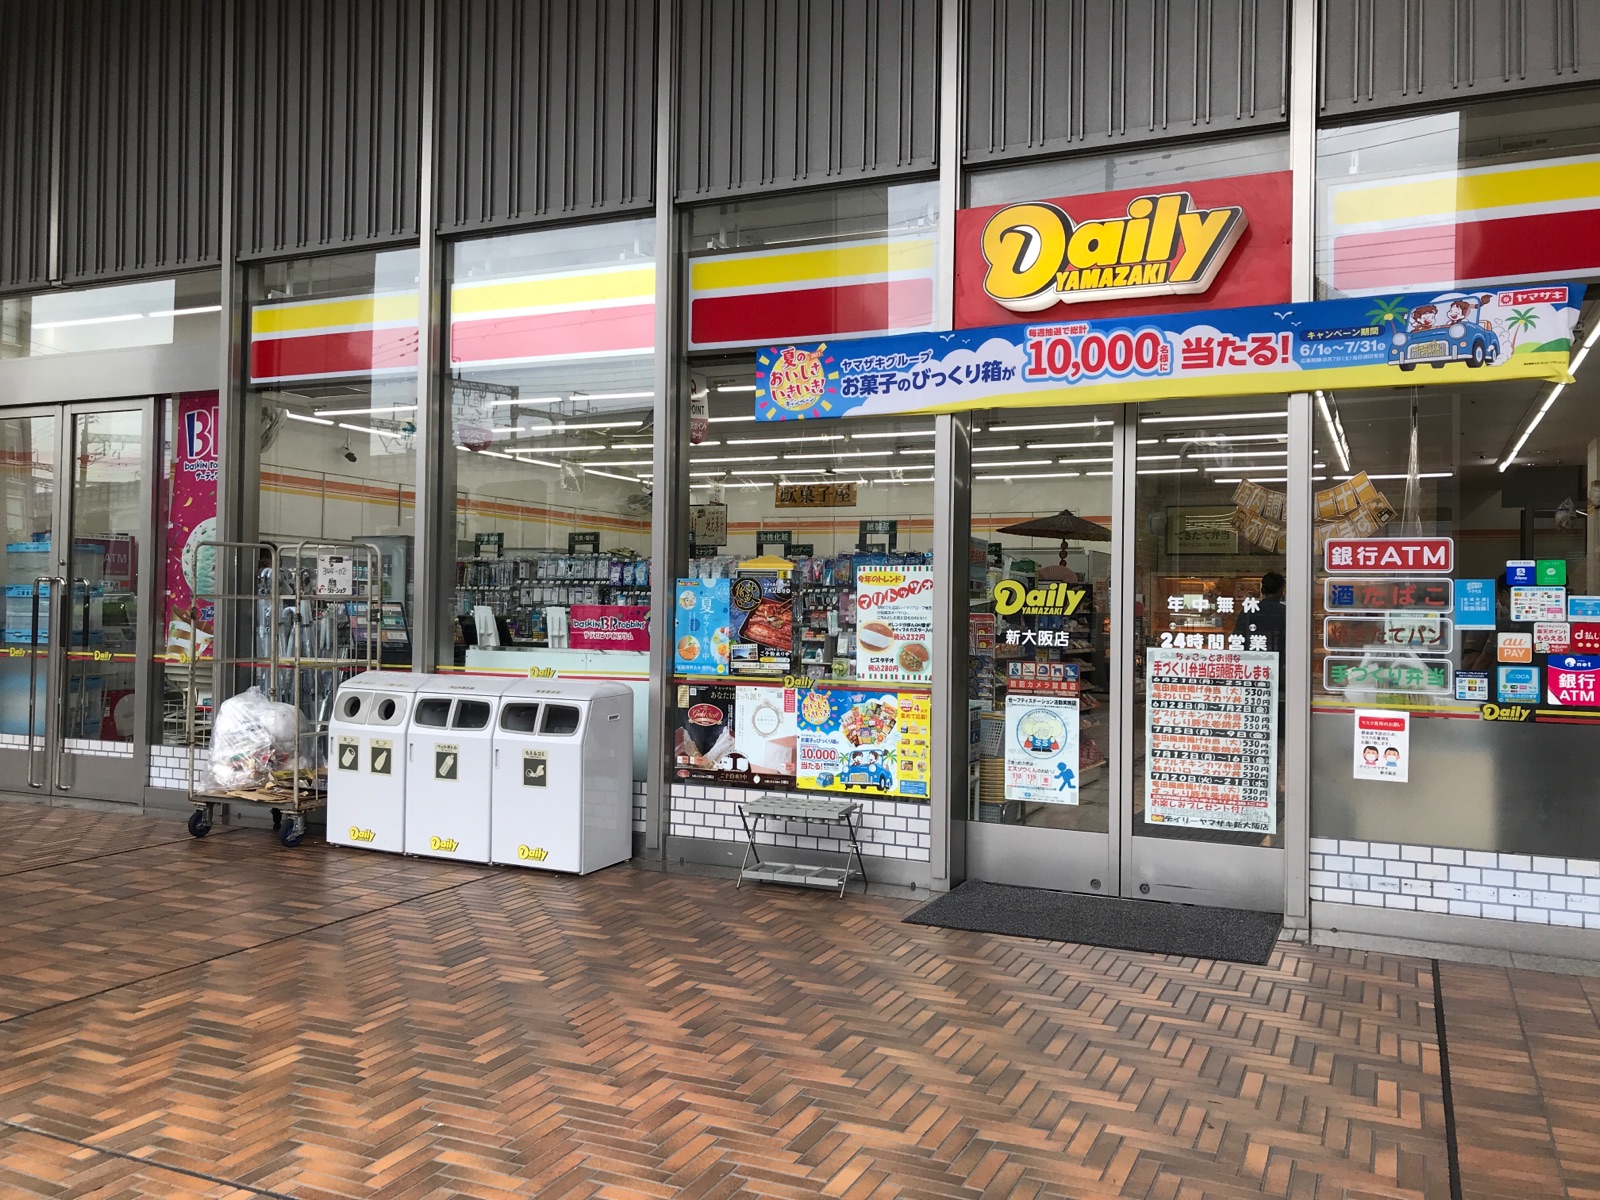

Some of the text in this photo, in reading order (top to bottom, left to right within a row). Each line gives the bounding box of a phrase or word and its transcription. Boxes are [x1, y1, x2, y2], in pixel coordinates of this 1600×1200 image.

[983, 194, 1233, 299] Daily
[1055, 262, 1167, 292] YAMAZAKI
[1516, 291, 1563, 302] ヤマザキ
[1028, 325, 1087, 338] 毎週抽選で総計
[1307, 327, 1379, 340] キャンペーン期間
[781, 347, 807, 369] 夏の
[1028, 332, 1161, 378] 10,000
[1159, 345, 1169, 371] 名様に
[1181, 334, 1290, 370] 当たる!
[841, 351, 933, 372] ヤマザキグループ
[770, 362, 820, 386] おいしさ
[841, 359, 1017, 396] お菓子のびっくり箱が
[771, 378, 826, 401] いきいき!
[785, 396, 815, 408] キャンペーン
[184, 460, 208, 471] baskin
[1174, 530, 1230, 541] できたて弁当
[1331, 546, 1446, 566] 銀行ATM
[993, 579, 1087, 616] Daily
[1331, 584, 1445, 606] 酒 たばこ
[1021, 606, 1063, 615] YAMAZAKI
[1167, 596, 1260, 613] 年中無休
[573, 616, 646, 630] baskin BR robbins
[893, 633, 926, 641] 税込232円
[1005, 629, 1070, 647] 新大阪店
[1331, 625, 1445, 643] 焼きたてパン
[1160, 632, 1268, 652] 24時間営業
[1503, 638, 1527, 647] au
[9, 646, 27, 658] Daily
[94, 650, 113, 661] Daily
[1175, 652, 1242, 663] ちょこっとお得な
[1504, 648, 1526, 658] PAY
[530, 666, 556, 679] Daily
[868, 664, 899, 672] 税込280円
[1153, 660, 1272, 680] 手づくり弁当店頭販売します
[1331, 664, 1445, 686] 手づくり弁当
[784, 675, 815, 689] Daily
[1558, 673, 1596, 690] 銀行
[1244, 688, 1271, 697] 530円
[1559, 689, 1595, 702] ATM
[1244, 697, 1270, 706] 530円
[1152, 709, 1270, 724] ダブルチキンカツ弁当 530円
[1482, 703, 1531, 722] Daily
[1243, 723, 1270, 731] 550円
[1242, 740, 1269, 748] 530円
[801, 748, 836, 761] 10,000
[800, 761, 823, 770] 当たる!
[1152, 757, 1269, 773] ダブルチキンカツ弁当 530円
[1242, 771, 1269, 780] 530円
[1242, 787, 1268, 796] 530円
[1164, 815, 1269, 831] デイリーヤマザキ新大阪店
[349, 826, 376, 842] Daily
[430, 835, 459, 852] Daily
[517, 844, 549, 862] Daily
